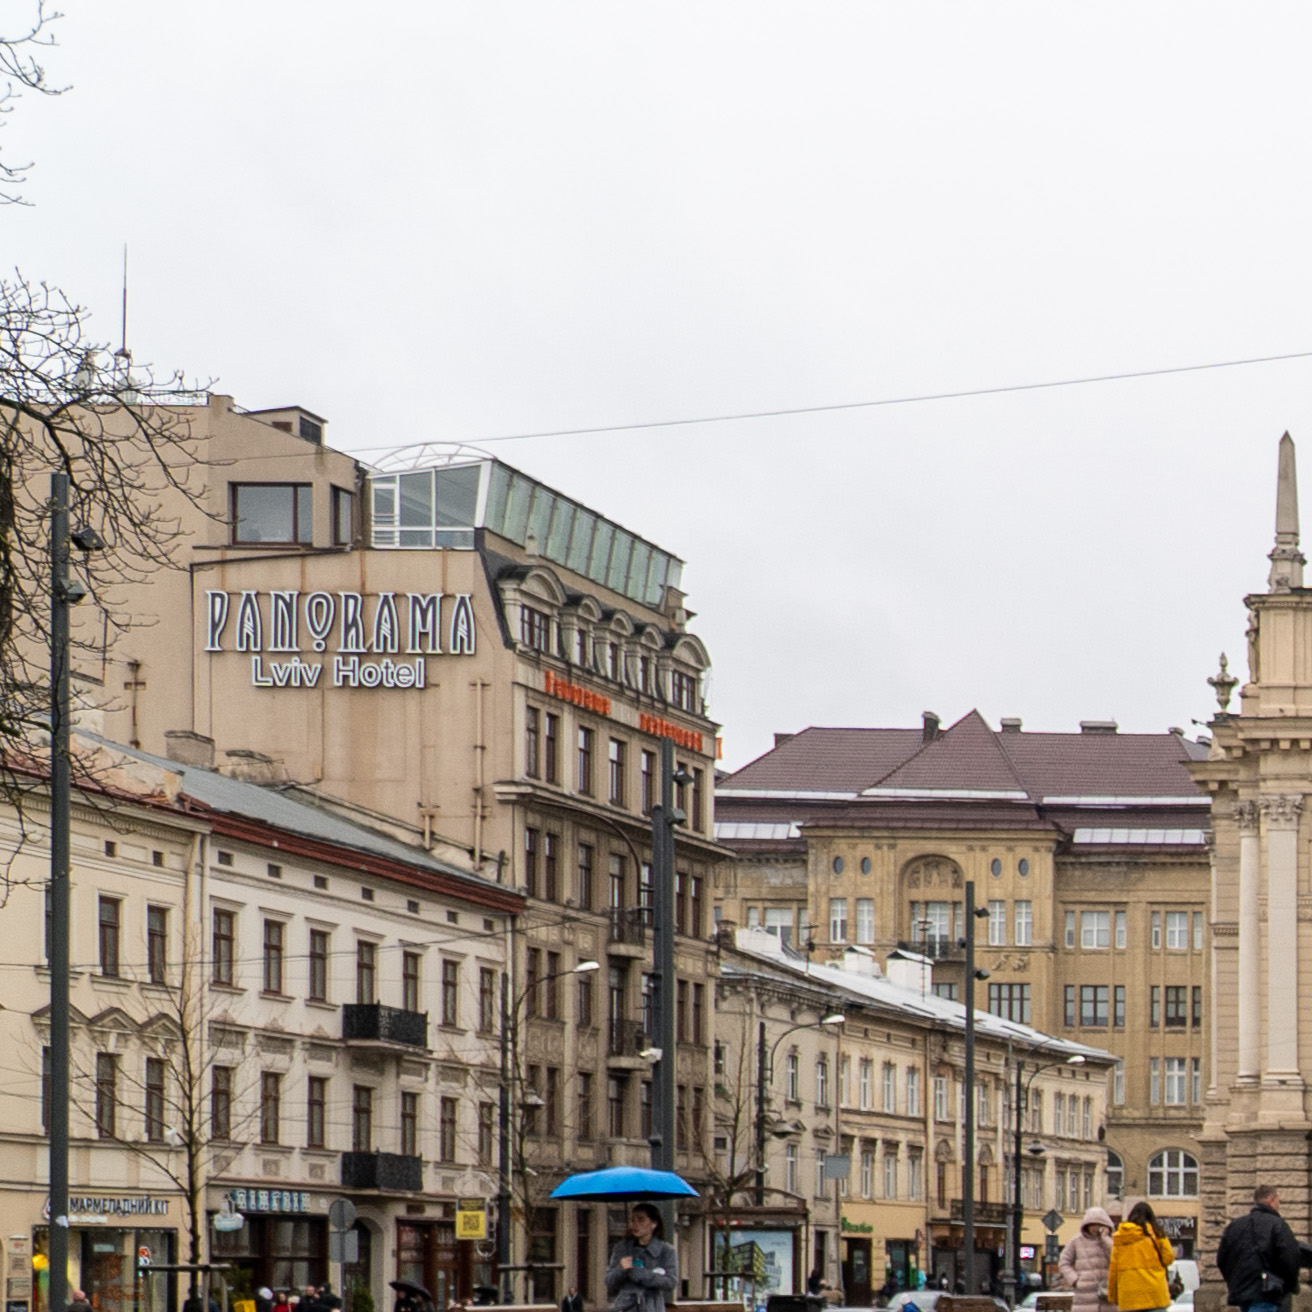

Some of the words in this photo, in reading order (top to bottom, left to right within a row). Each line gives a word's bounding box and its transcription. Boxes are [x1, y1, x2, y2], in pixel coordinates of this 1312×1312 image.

[204, 590, 476, 655] PANORAMA
[251, 655, 322, 688] Lviv
[333, 655, 426, 689] Hotel
